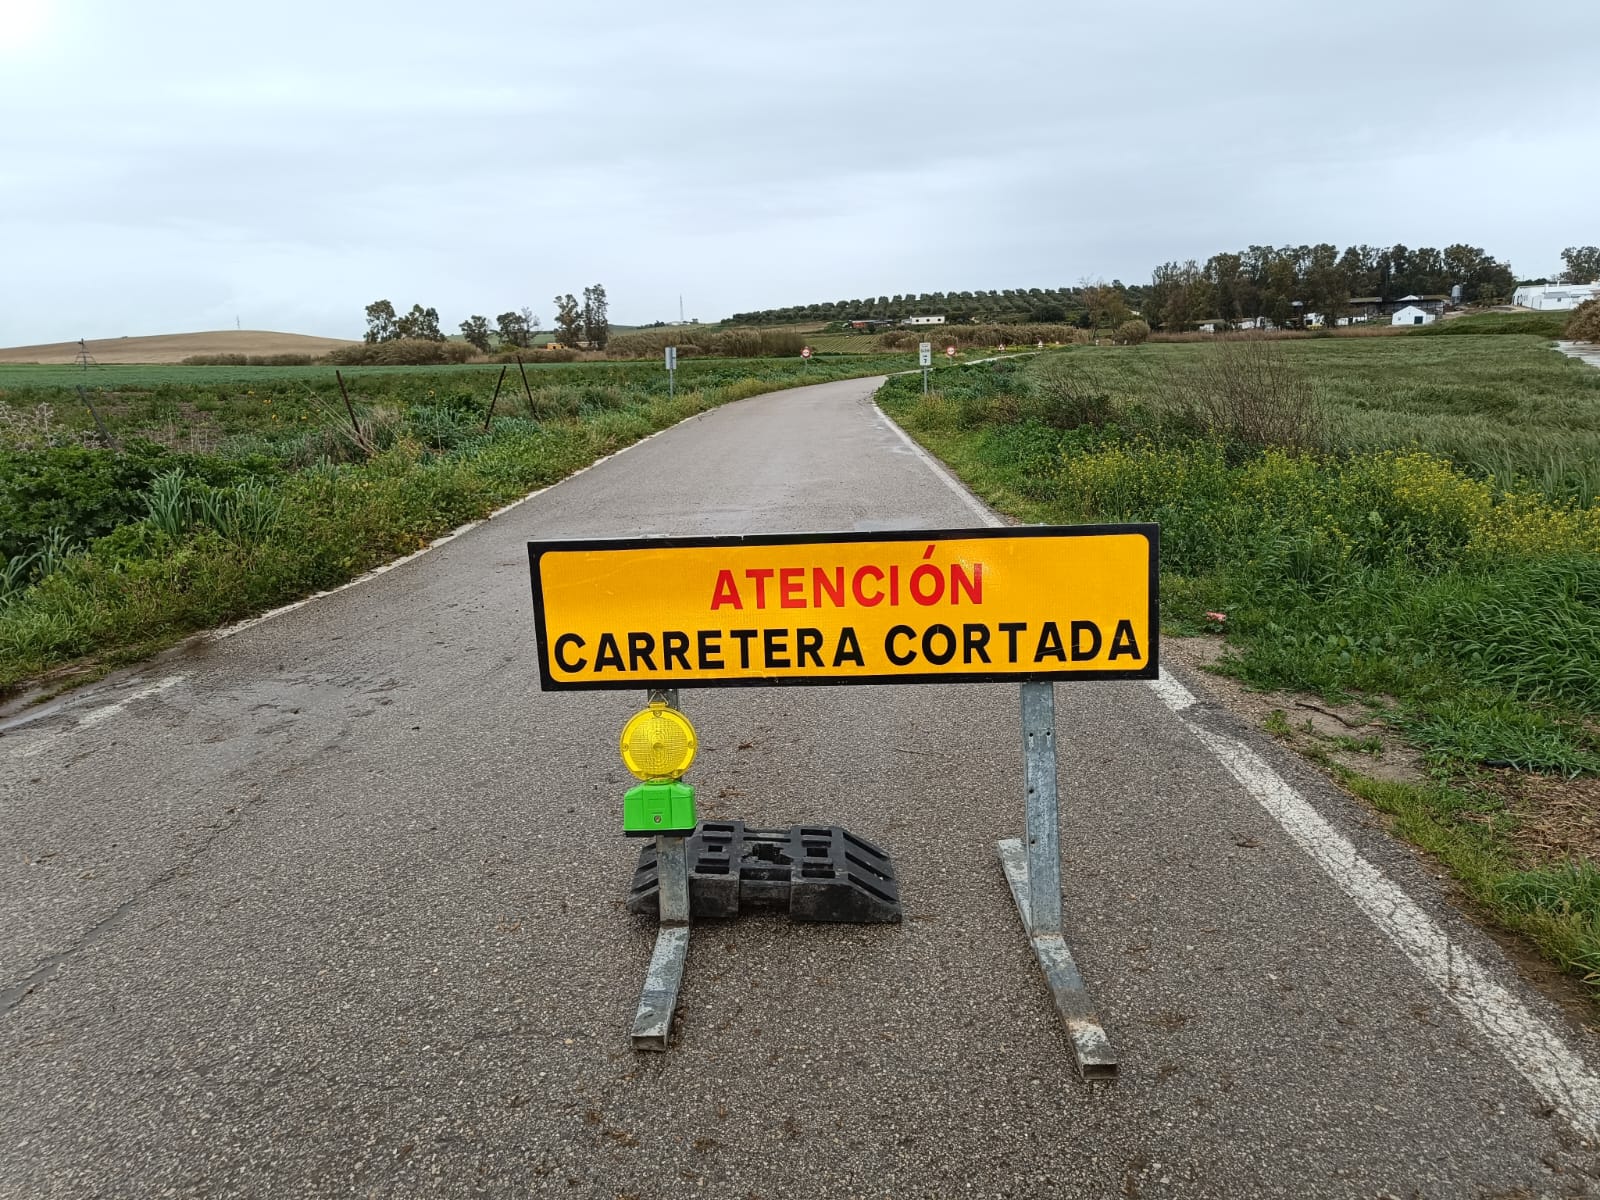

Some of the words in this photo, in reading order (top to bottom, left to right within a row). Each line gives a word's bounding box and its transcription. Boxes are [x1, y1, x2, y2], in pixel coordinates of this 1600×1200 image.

[711, 545, 983, 610] ATENCIÓN
[554, 627, 865, 673] CARRETERA
[885, 619, 1141, 666] CORTADA
